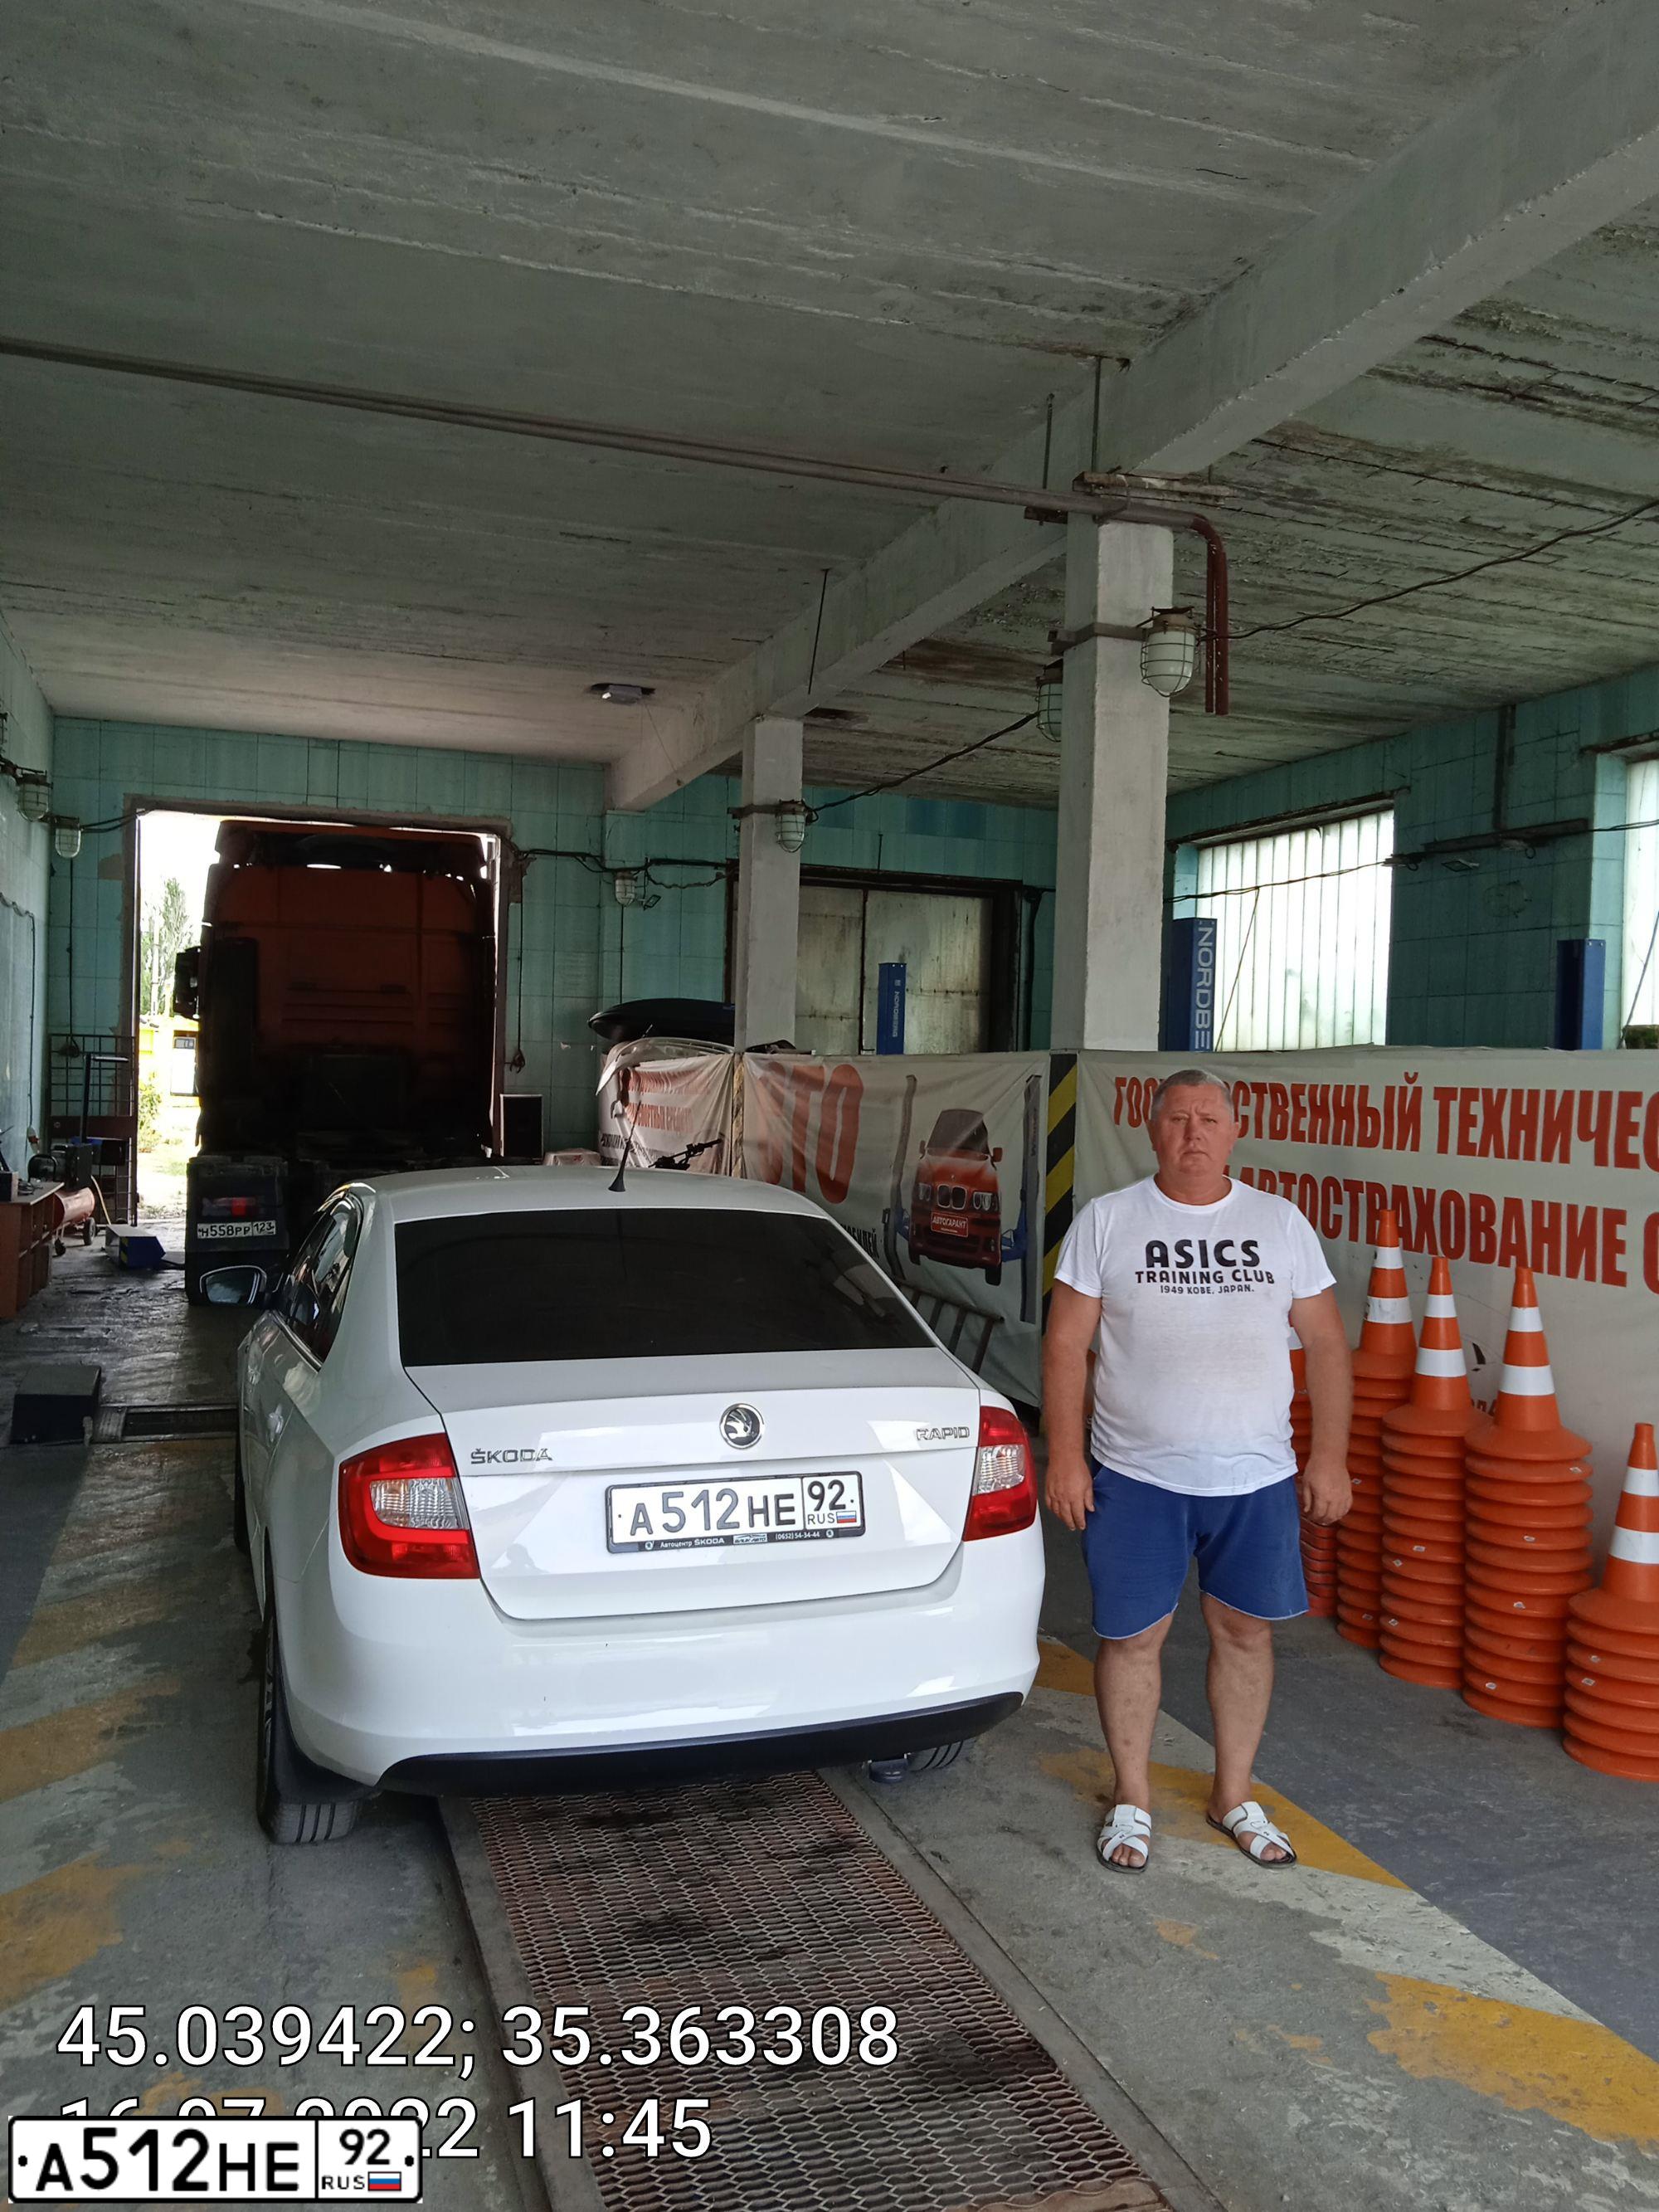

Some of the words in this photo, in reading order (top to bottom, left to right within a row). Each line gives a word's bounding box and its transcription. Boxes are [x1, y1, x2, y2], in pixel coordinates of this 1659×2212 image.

[1194, 926, 1214, 1050] NORDBE
[1113, 1072, 1423, 1152] ГОССТВЕННЫЙ
[1146, 1240, 1260, 1269] ASICS
[1135, 1270, 1224, 1284] TRAINING
[1232, 1269, 1275, 1284] CLUB
[1160, 1285, 1184, 1294] 1949
[1187, 1286, 1214, 1294] KOBE,
[1218, 1284, 1255, 1294] JAPAN.
[916, 1426, 970, 1440] RAPID
[471, 1448, 553, 1464] ŠKODA
[630, 1488, 796, 1536] А512НЕ
[807, 1479, 846, 1511] 92
[807, 1511, 834, 1524] RUS
[694, 1537, 725, 1546] ŠKODA
